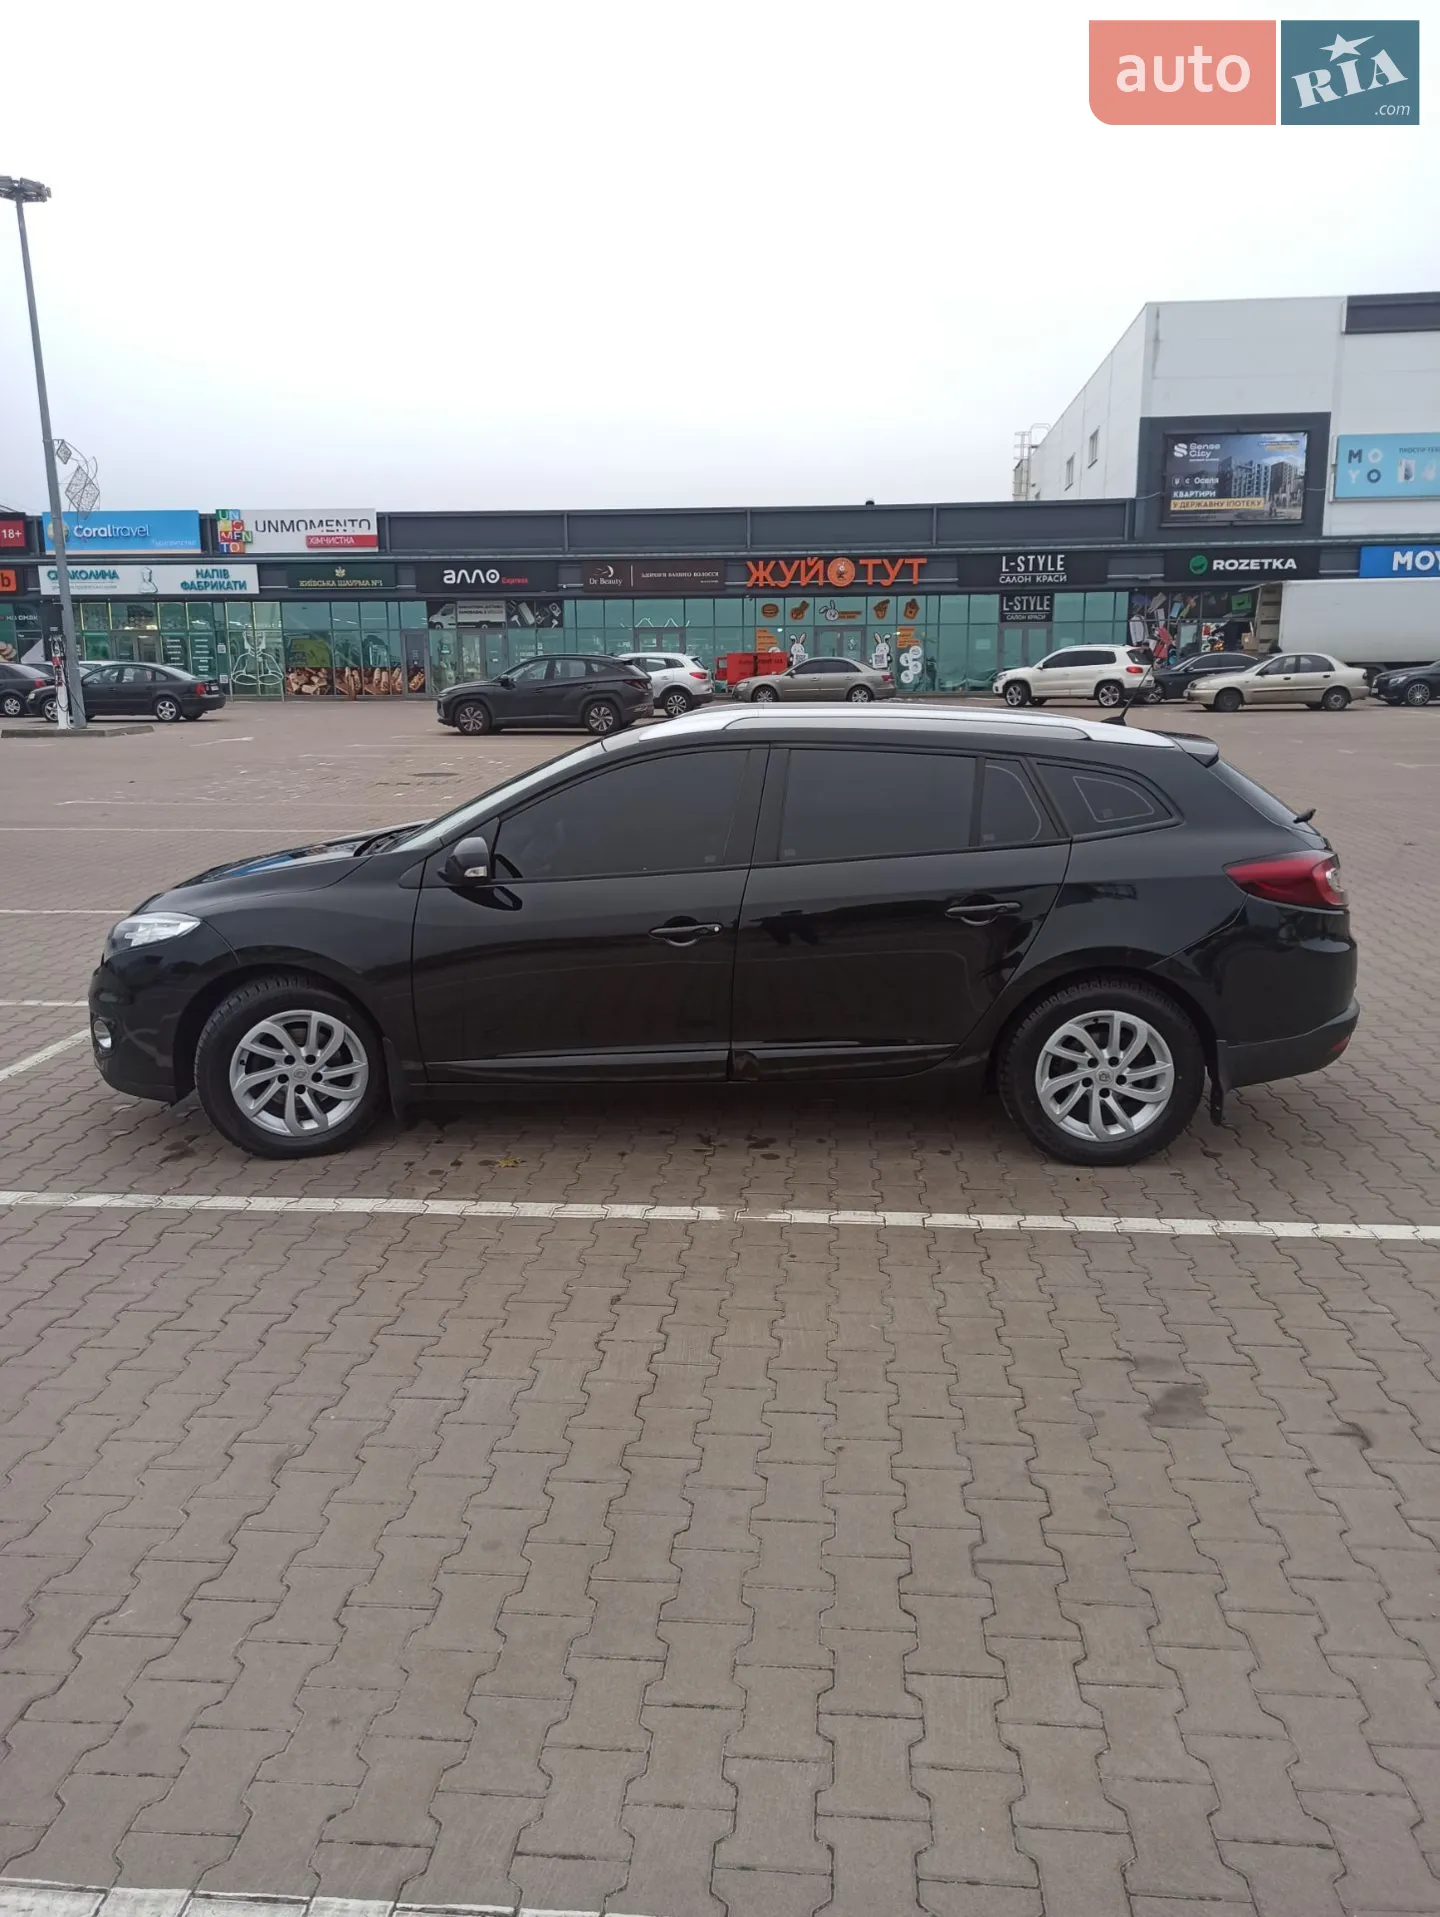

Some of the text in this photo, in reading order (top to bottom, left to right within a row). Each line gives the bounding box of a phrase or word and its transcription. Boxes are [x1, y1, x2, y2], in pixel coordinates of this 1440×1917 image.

[1189, 442, 1220, 450] Sense
[1189, 450, 1212, 458] City
[1173, 490, 1216, 498] КВАРТИРИ
[1179, 501, 1226, 509] ДЕРЖАВНУ
[255, 519, 371, 532] UNMOMENTO
[1, 528, 22, 539] 18+
[309, 536, 355, 545] ХІМЧИСТКА
[1002, 554, 1065, 572] L-STYLE
[1212, 558, 1297, 570] ROZETKA
[196, 568, 230, 579] НАПІВ
[745, 557, 824, 588] ЖУЙ
[859, 558, 927, 586] ТУТ
[299, 578, 336, 587] КИЇВСЬКА
[338, 579, 370, 587] ШАУРМА
[589, 577, 622, 586] Dr Beauty
[999, 574, 1067, 583] САЛОН КРАСИ
[181, 580, 247, 591] ФАБРИКАТИ
[1003, 595, 1051, 611] L-STYLE
